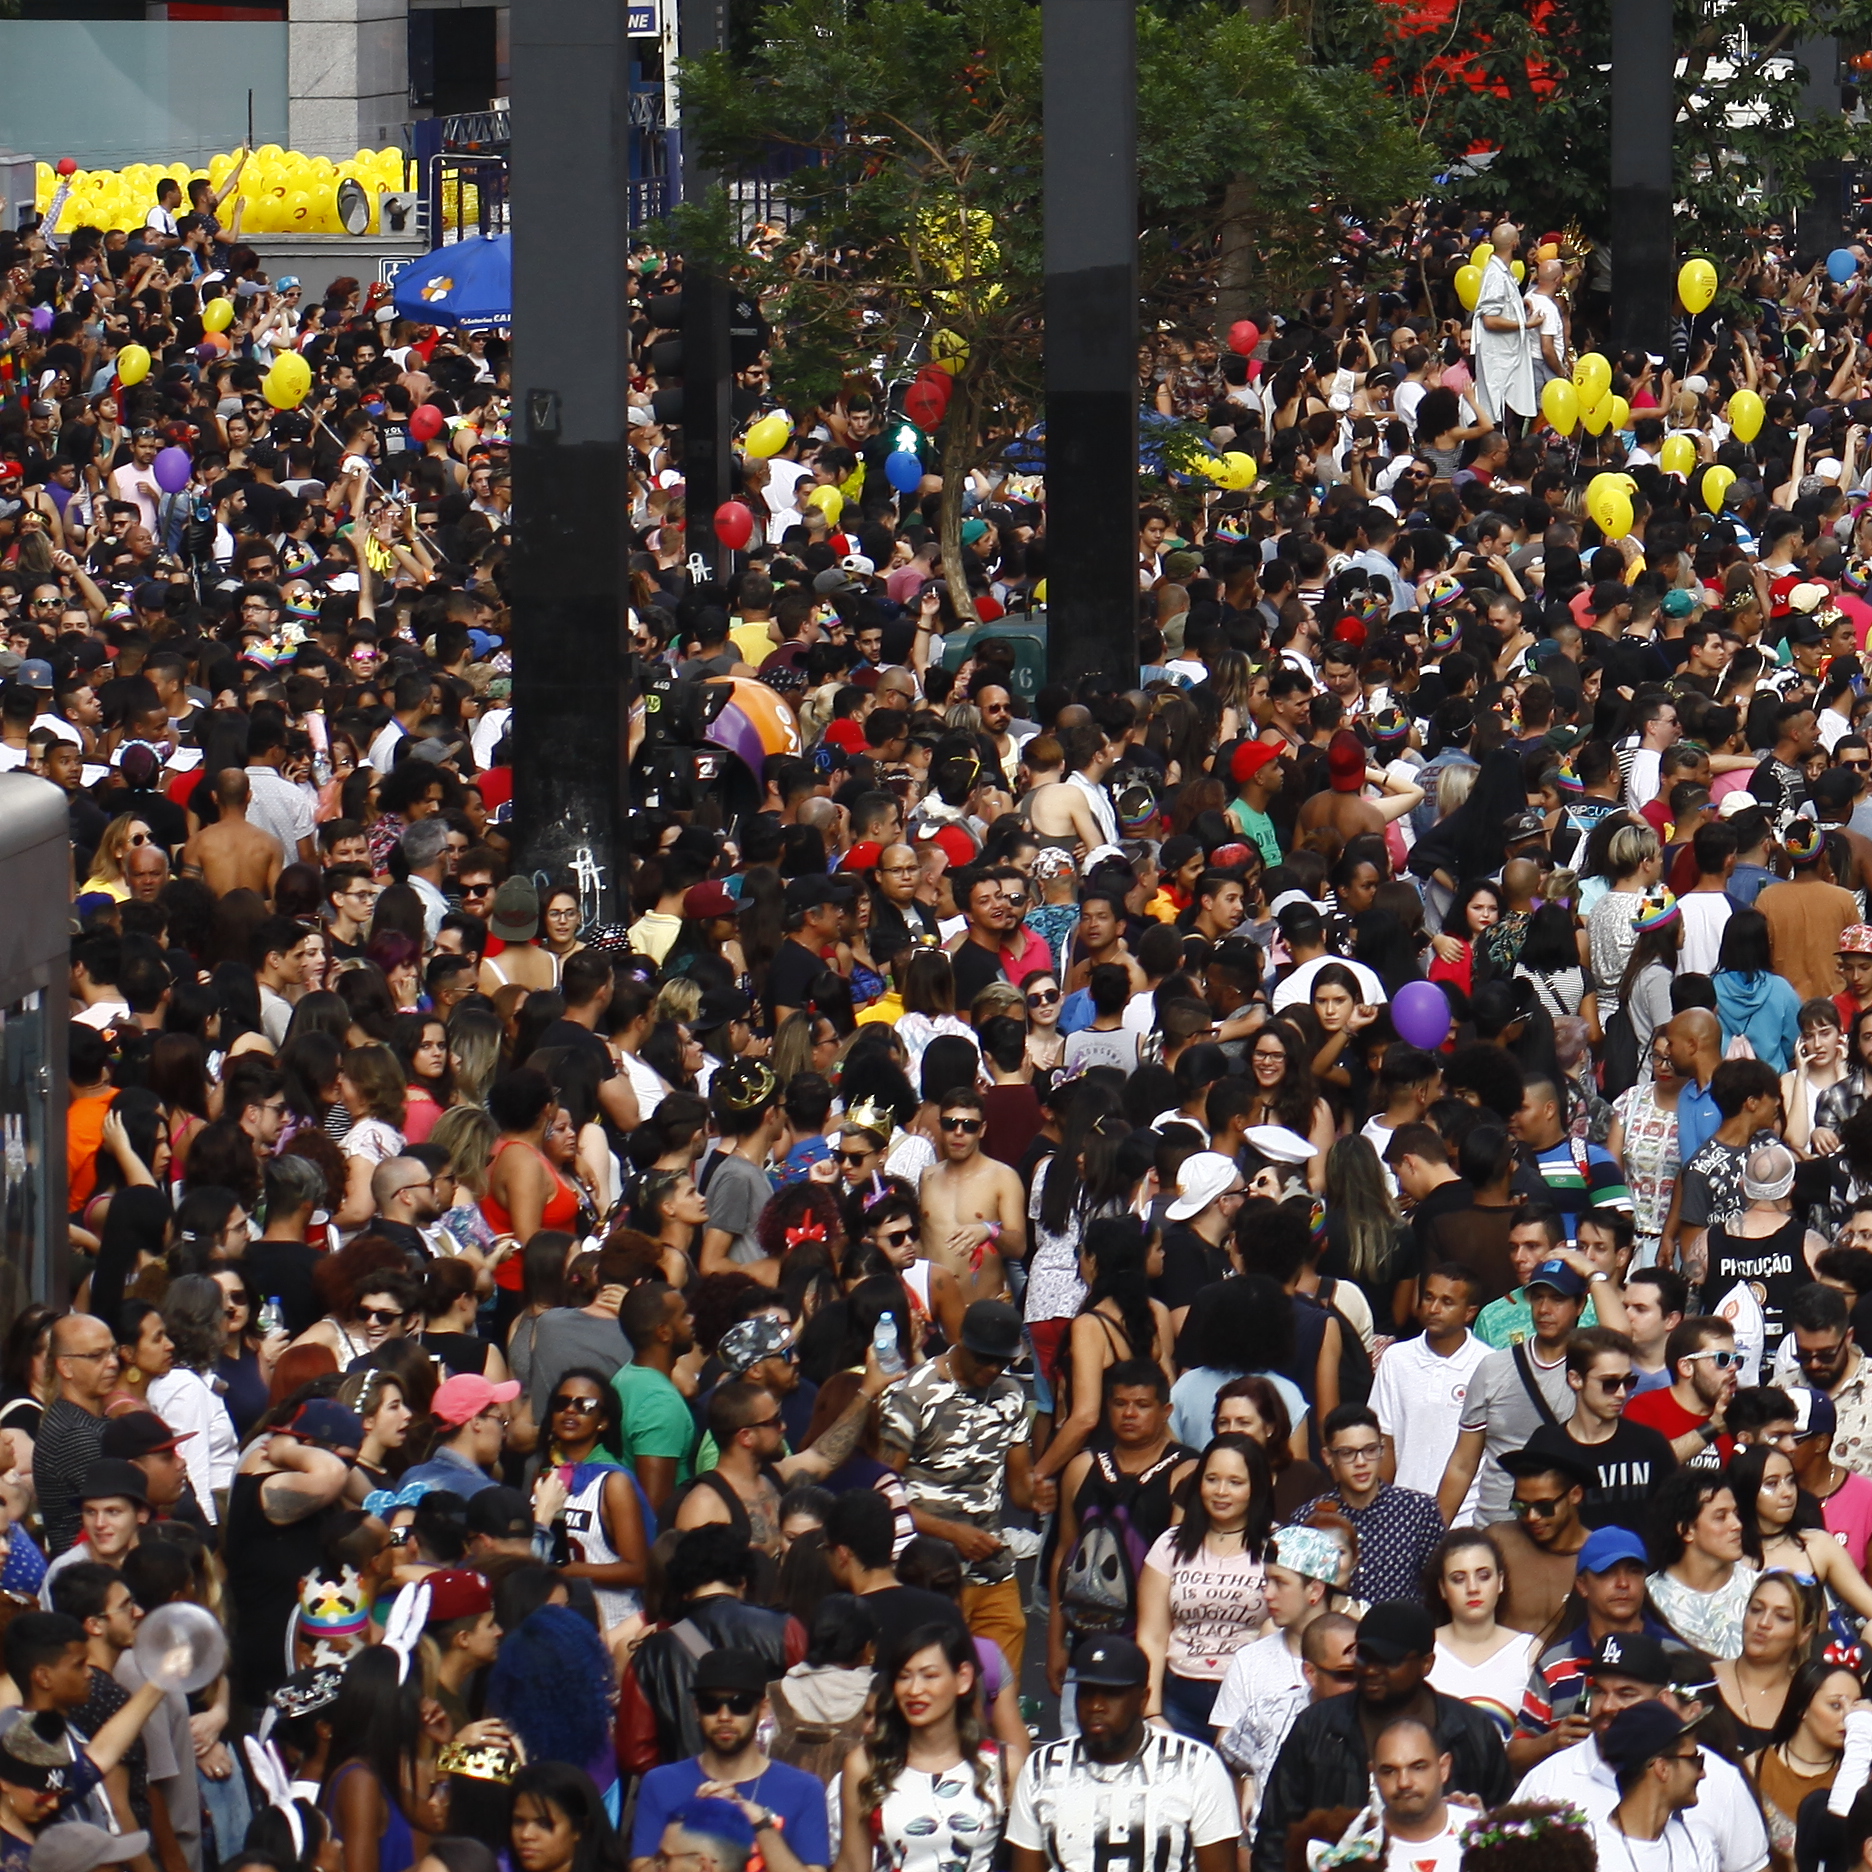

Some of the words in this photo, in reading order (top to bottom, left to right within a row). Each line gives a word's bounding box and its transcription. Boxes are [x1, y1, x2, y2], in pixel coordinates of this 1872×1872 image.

[1719, 1252, 1793, 1279] PRODUÇÃO
[1138, 1451, 1181, 1485] SPORT
[1597, 1460, 1651, 1489] VIN
[1171, 1570, 1268, 1589] TOGETHER
[1182, 1585, 1194, 1601] IS
[1203, 1586, 1243, 1602] OUR
[1186, 1622, 1239, 1639] PLACE
